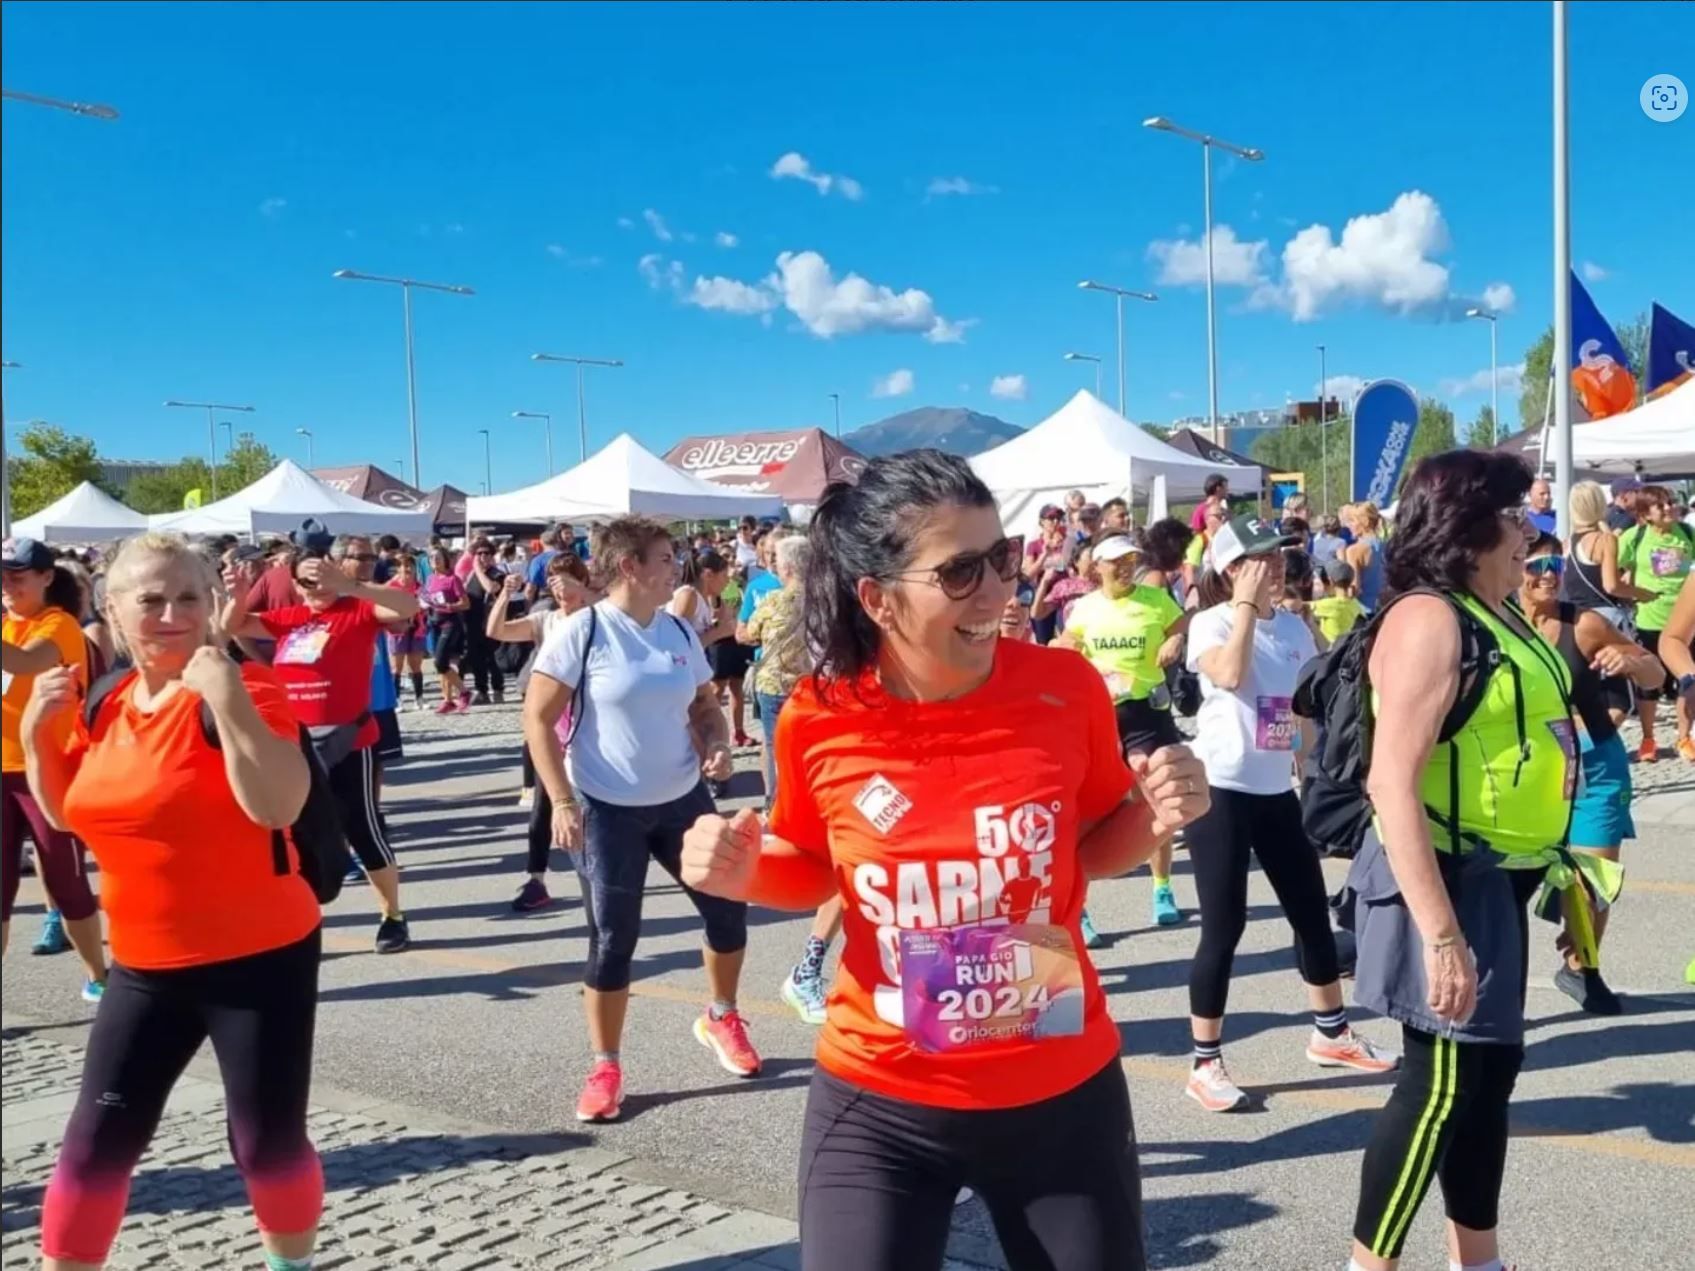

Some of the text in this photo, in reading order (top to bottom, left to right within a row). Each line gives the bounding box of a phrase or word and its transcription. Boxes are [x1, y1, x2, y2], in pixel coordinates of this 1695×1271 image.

[1091, 636, 1147, 651] TAAAC!!
[873, 794, 906, 828] TECNO
[990, 951, 1013, 962] GIO
[955, 961, 1014, 986] RUN
[937, 984, 1051, 1021] 2024
